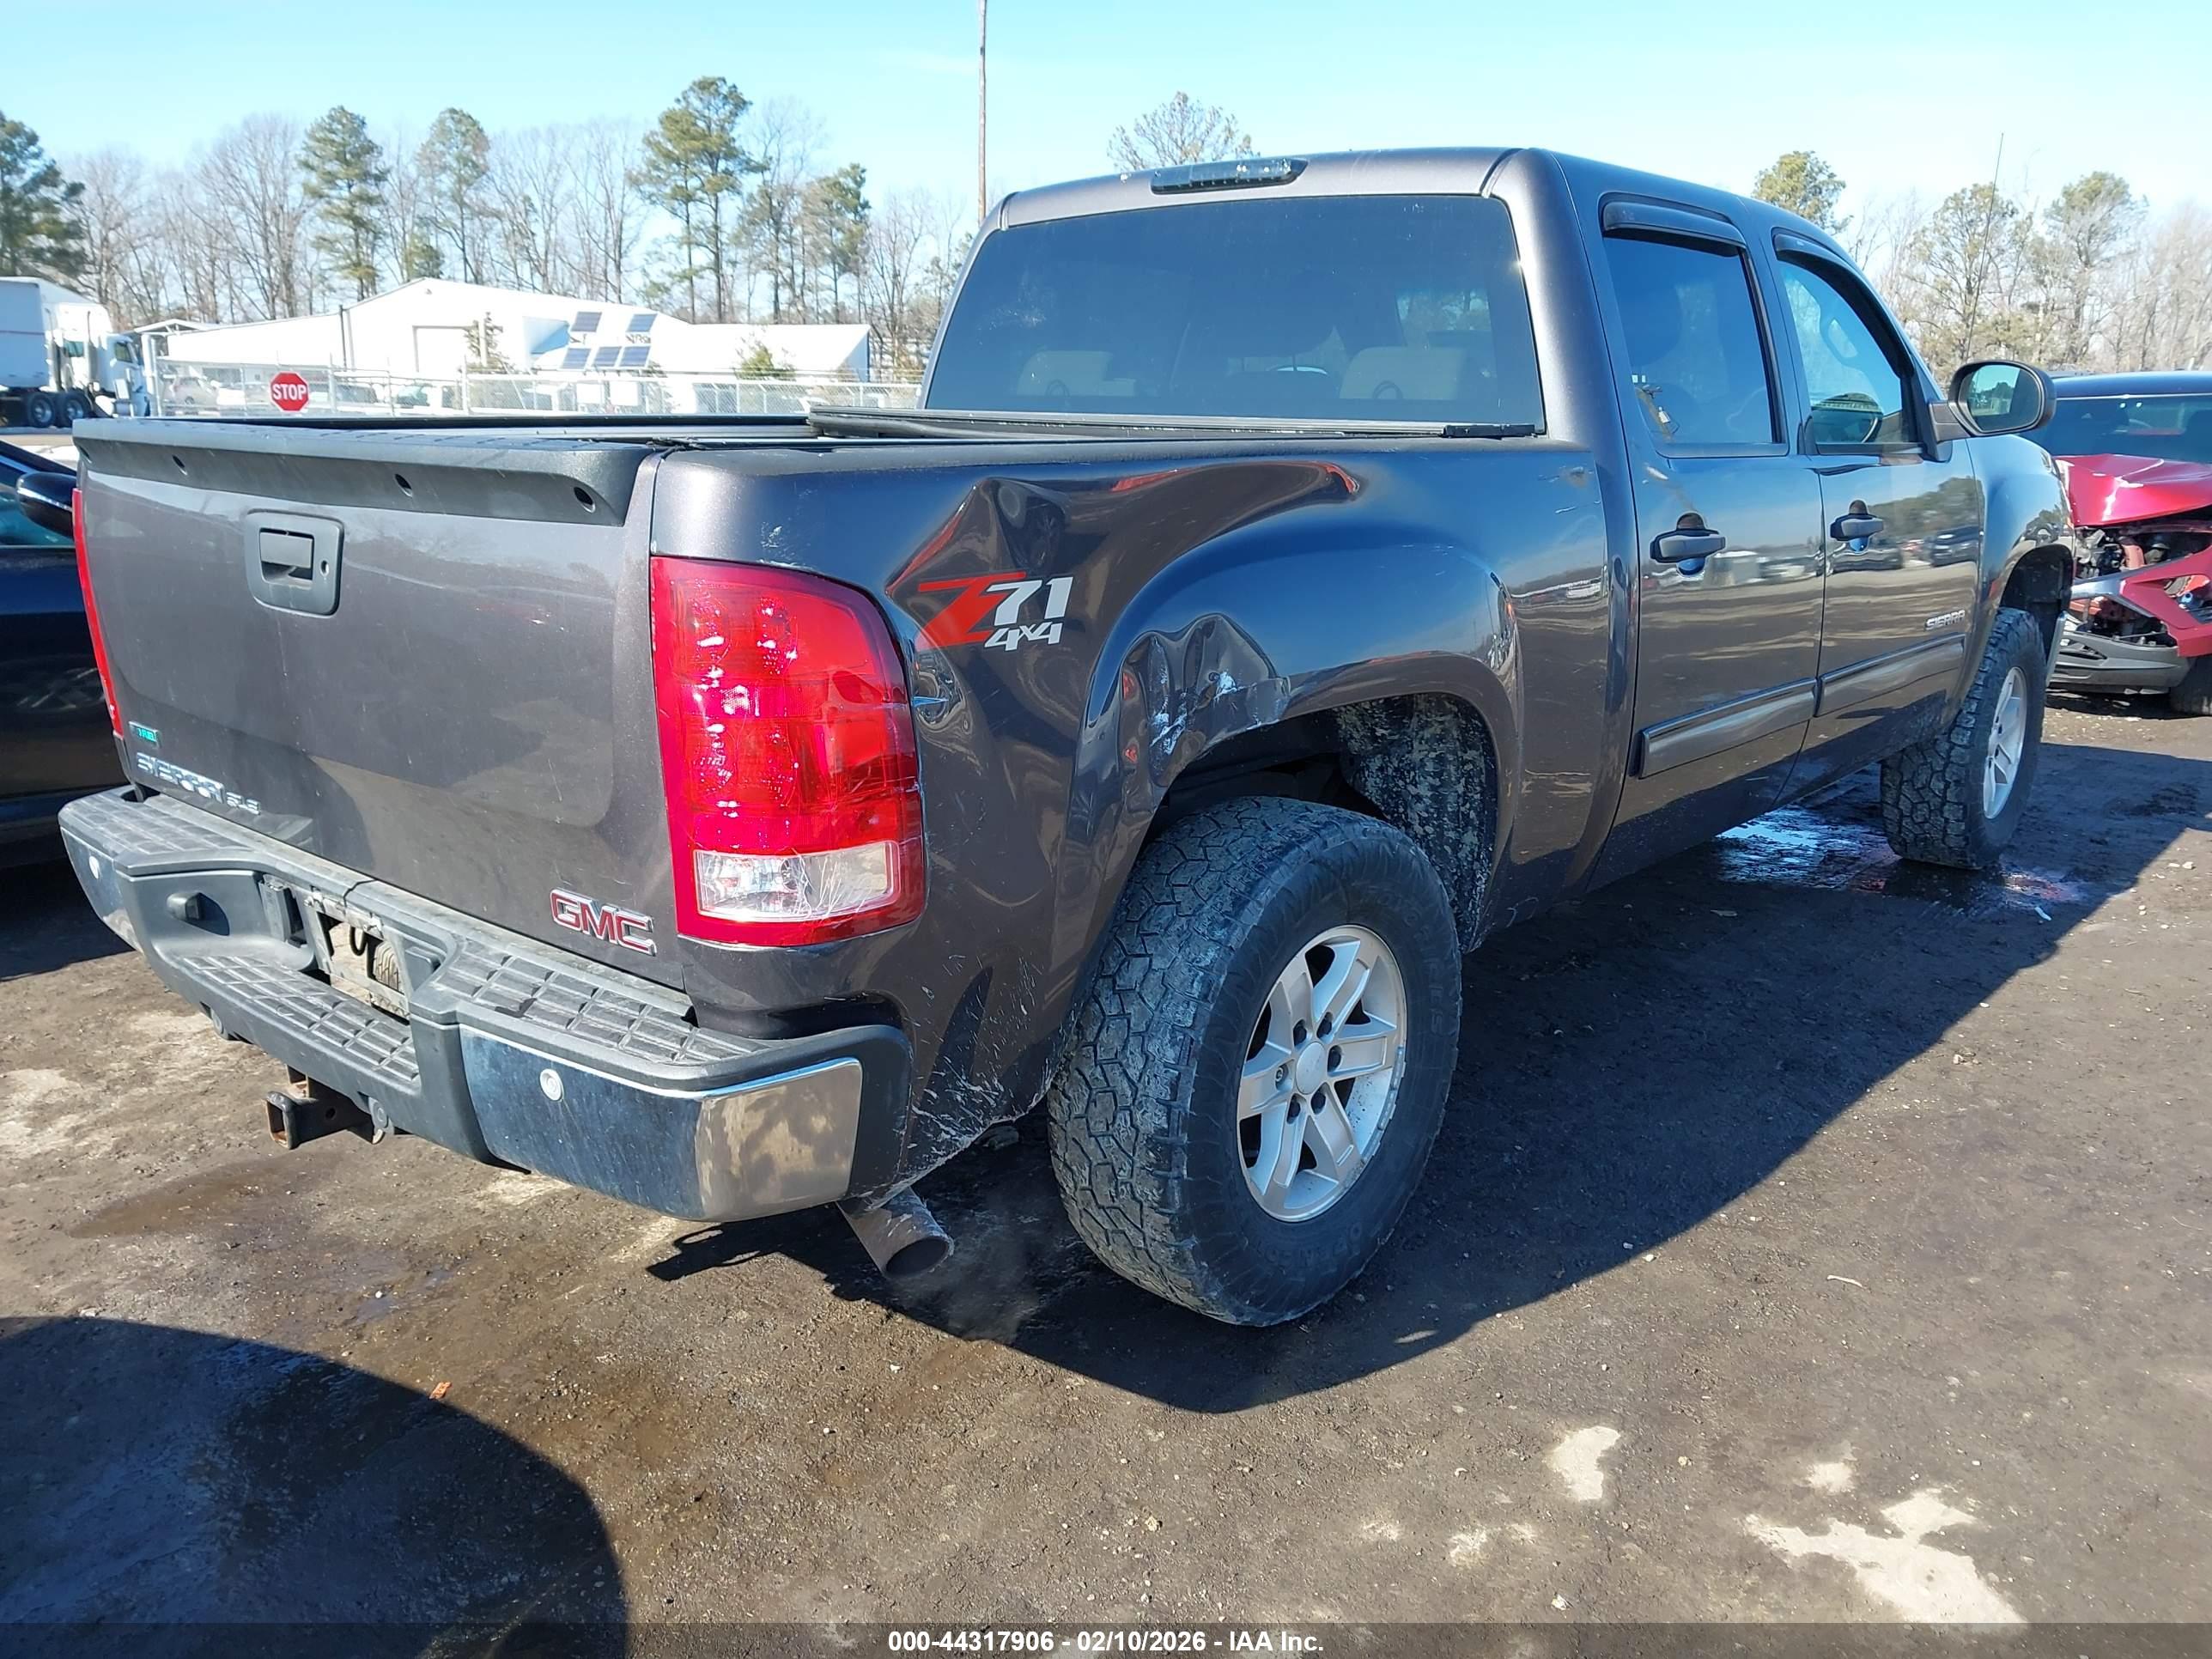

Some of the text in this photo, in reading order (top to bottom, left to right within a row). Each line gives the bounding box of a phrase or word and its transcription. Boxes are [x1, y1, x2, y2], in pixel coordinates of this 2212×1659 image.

[272, 383, 307, 400] STOP
[915, 570, 1073, 650] Z71
[1925, 609, 1965, 630] SIERRA
[137, 752, 226, 804] SIERRA
[550, 888, 658, 957] GMC
